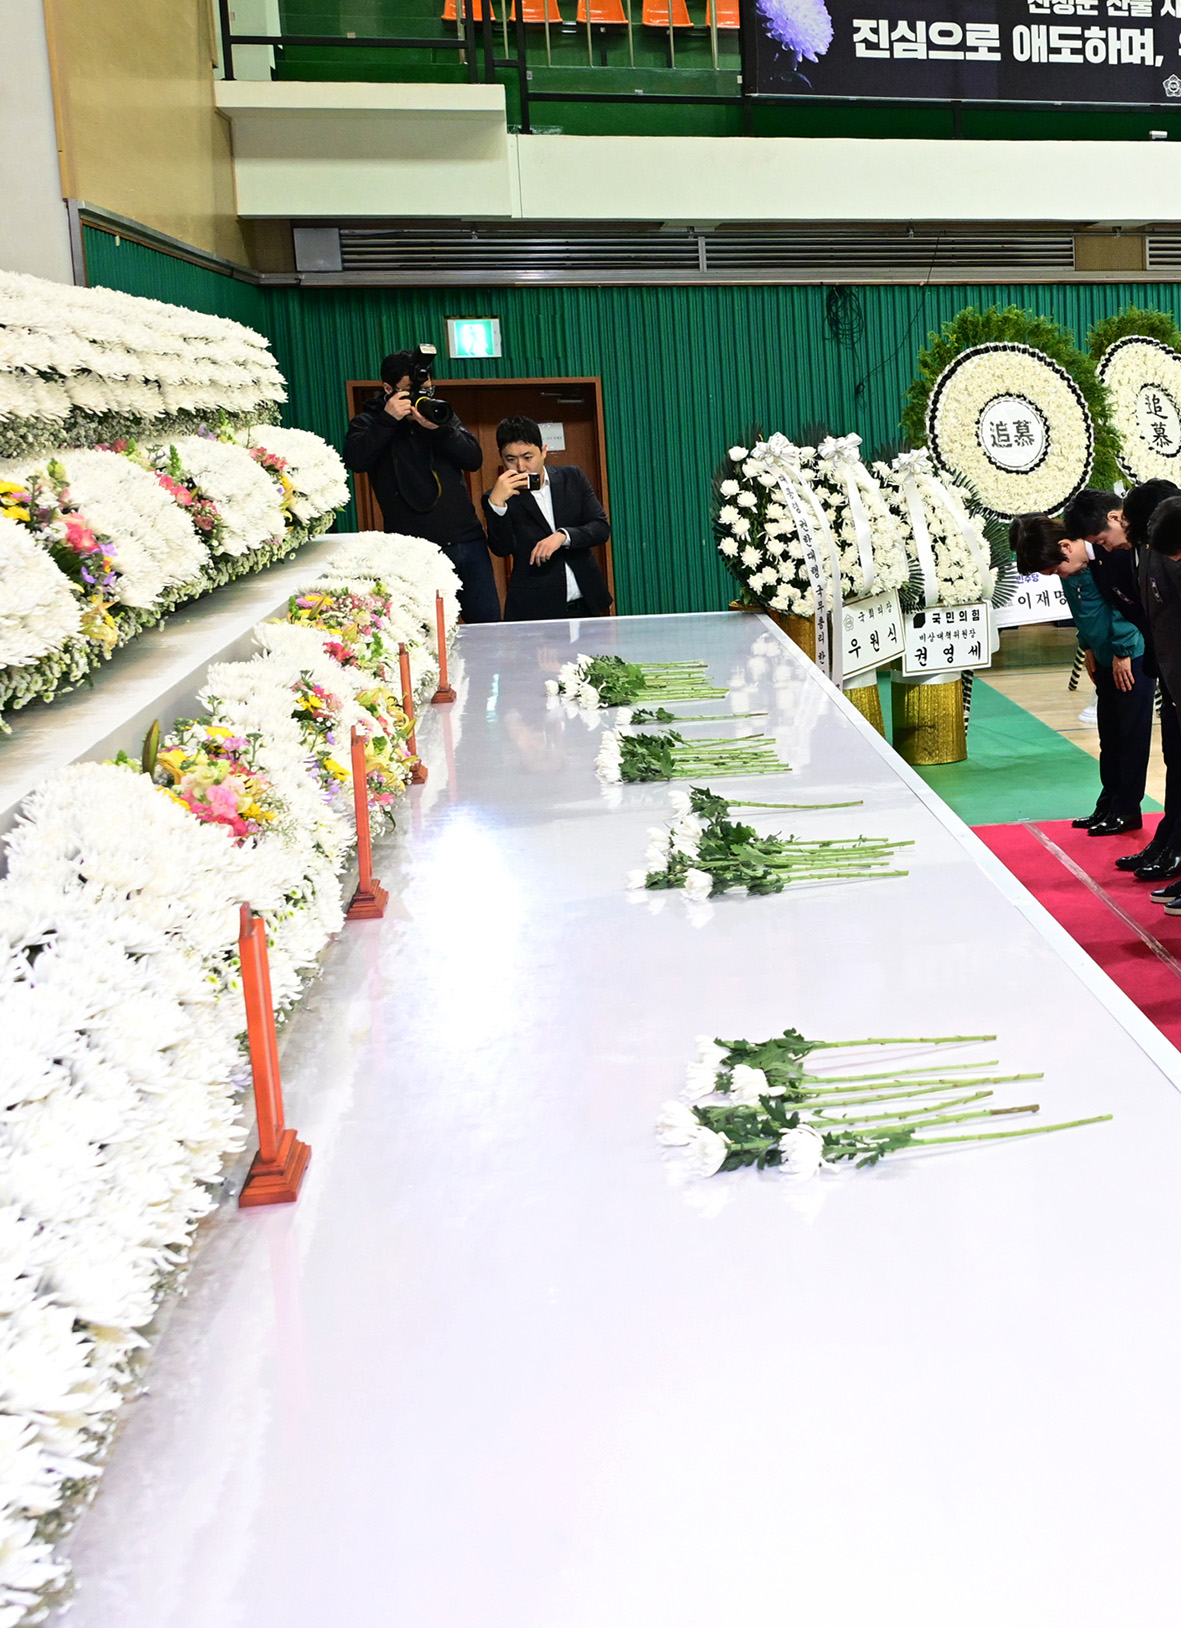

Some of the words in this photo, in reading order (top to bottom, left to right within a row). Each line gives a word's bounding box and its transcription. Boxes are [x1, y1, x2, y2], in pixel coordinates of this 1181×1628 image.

[853, 19, 1001, 61] 진심으로
[1012, 24, 1163, 67] 애도하며,
[990, 420, 1035, 448] 追慕
[1145, 394, 1173, 448] 追慕
[1017, 590, 1067, 610] 이재명
[932, 609, 980, 625] 국민의힘
[848, 622, 898, 659] 우원식
[914, 640, 982, 667] 권영세
